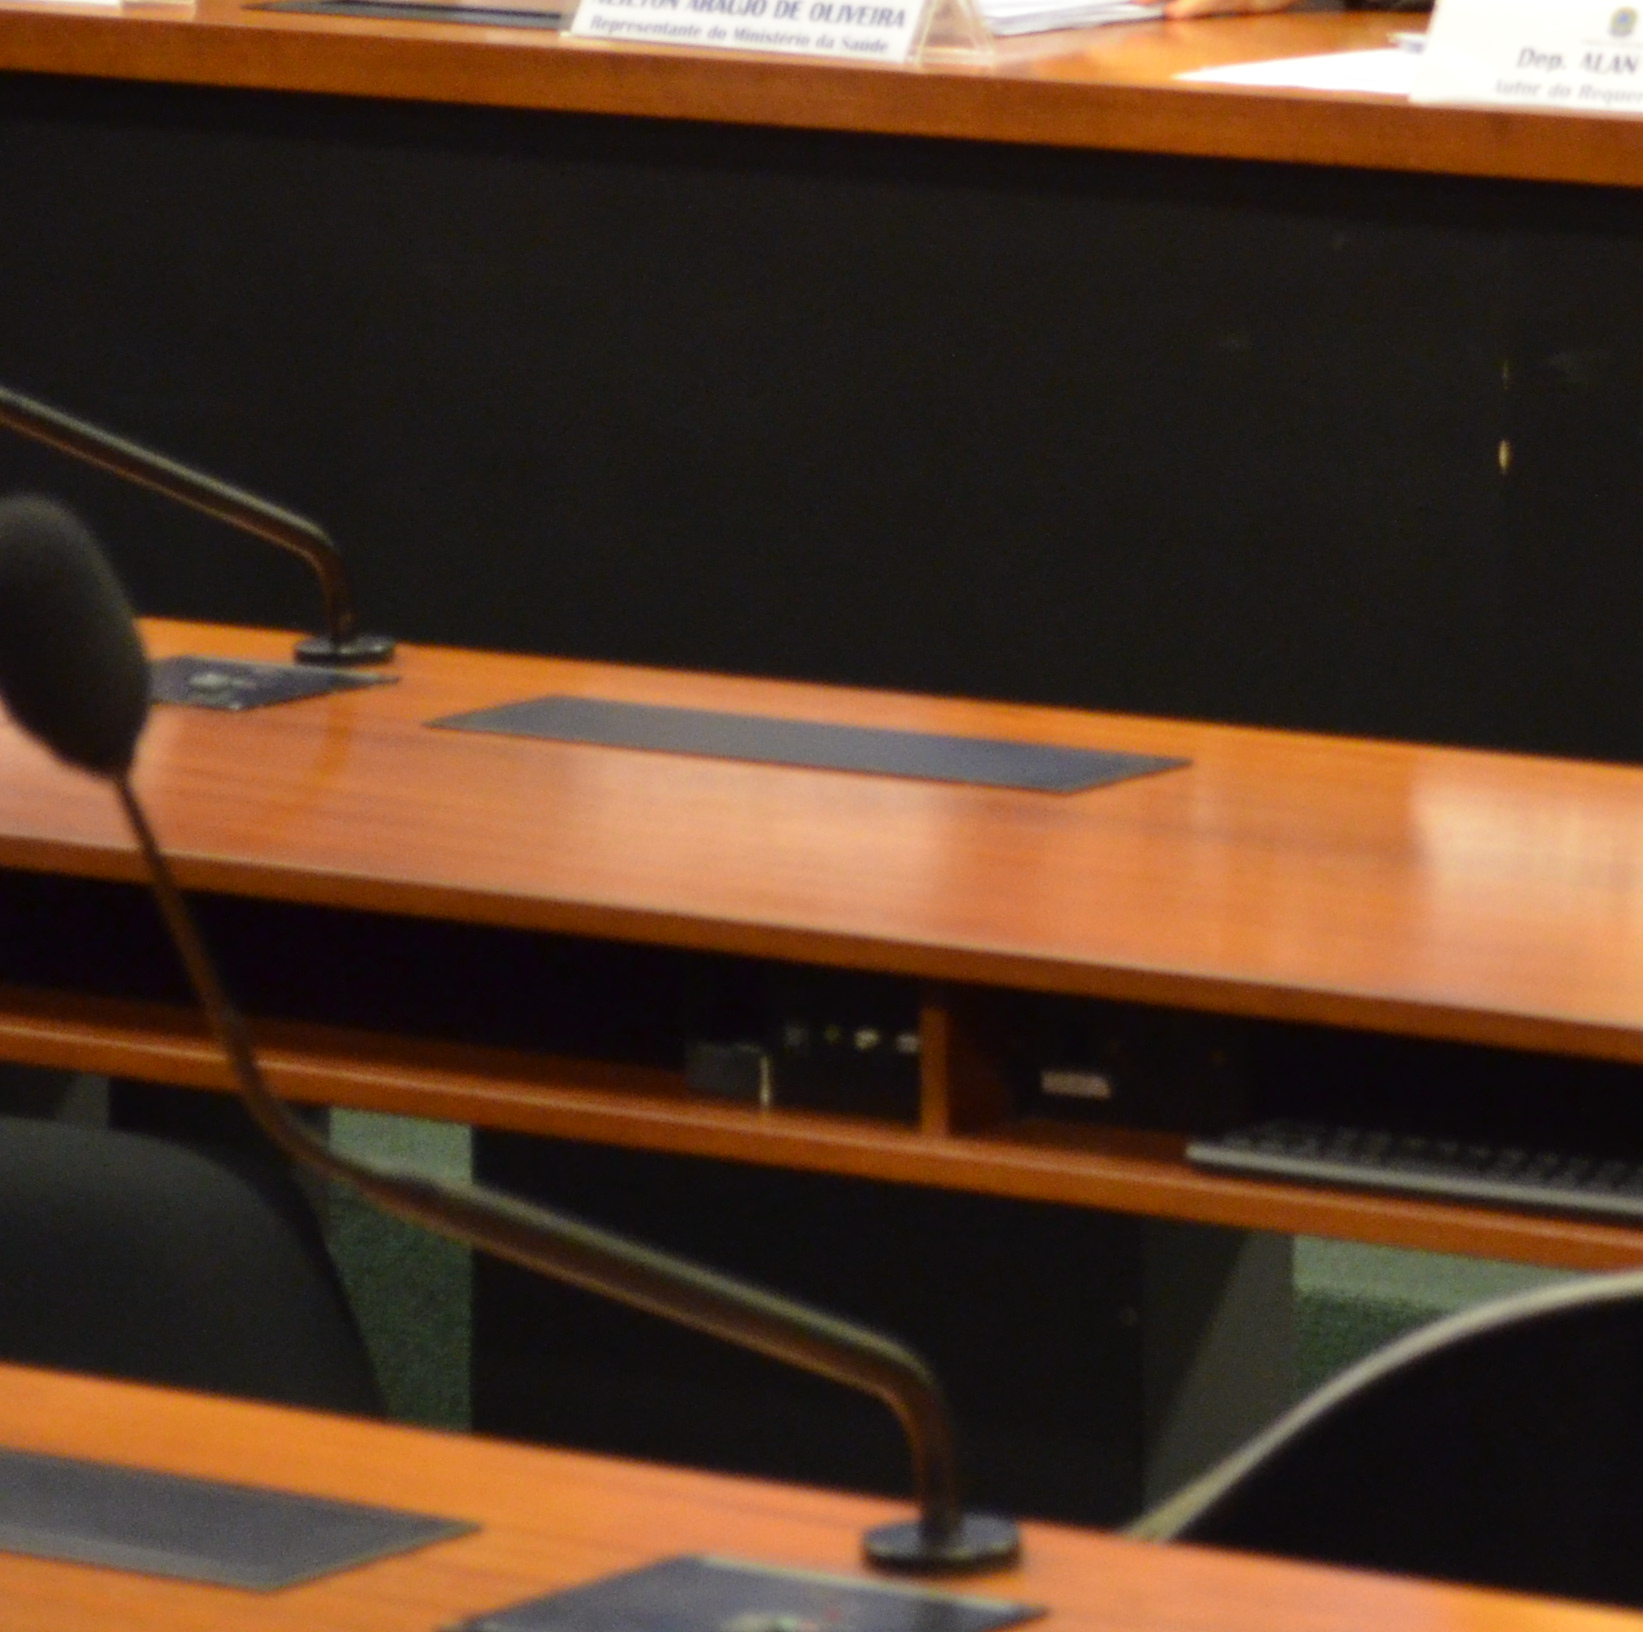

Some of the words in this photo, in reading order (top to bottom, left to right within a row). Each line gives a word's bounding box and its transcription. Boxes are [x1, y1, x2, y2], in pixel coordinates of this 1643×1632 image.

[809, 2, 907, 28] OLIVEIRA
[589, 14, 703, 39] Representante
[707, 22, 728, 40] do
[733, 24, 811, 49] Ministério
[816, 32, 835, 50] da
[841, 34, 890, 54] Saúde
[1517, 47, 1566, 73] Dep.
[1580, 52, 1638, 76] ALAN
